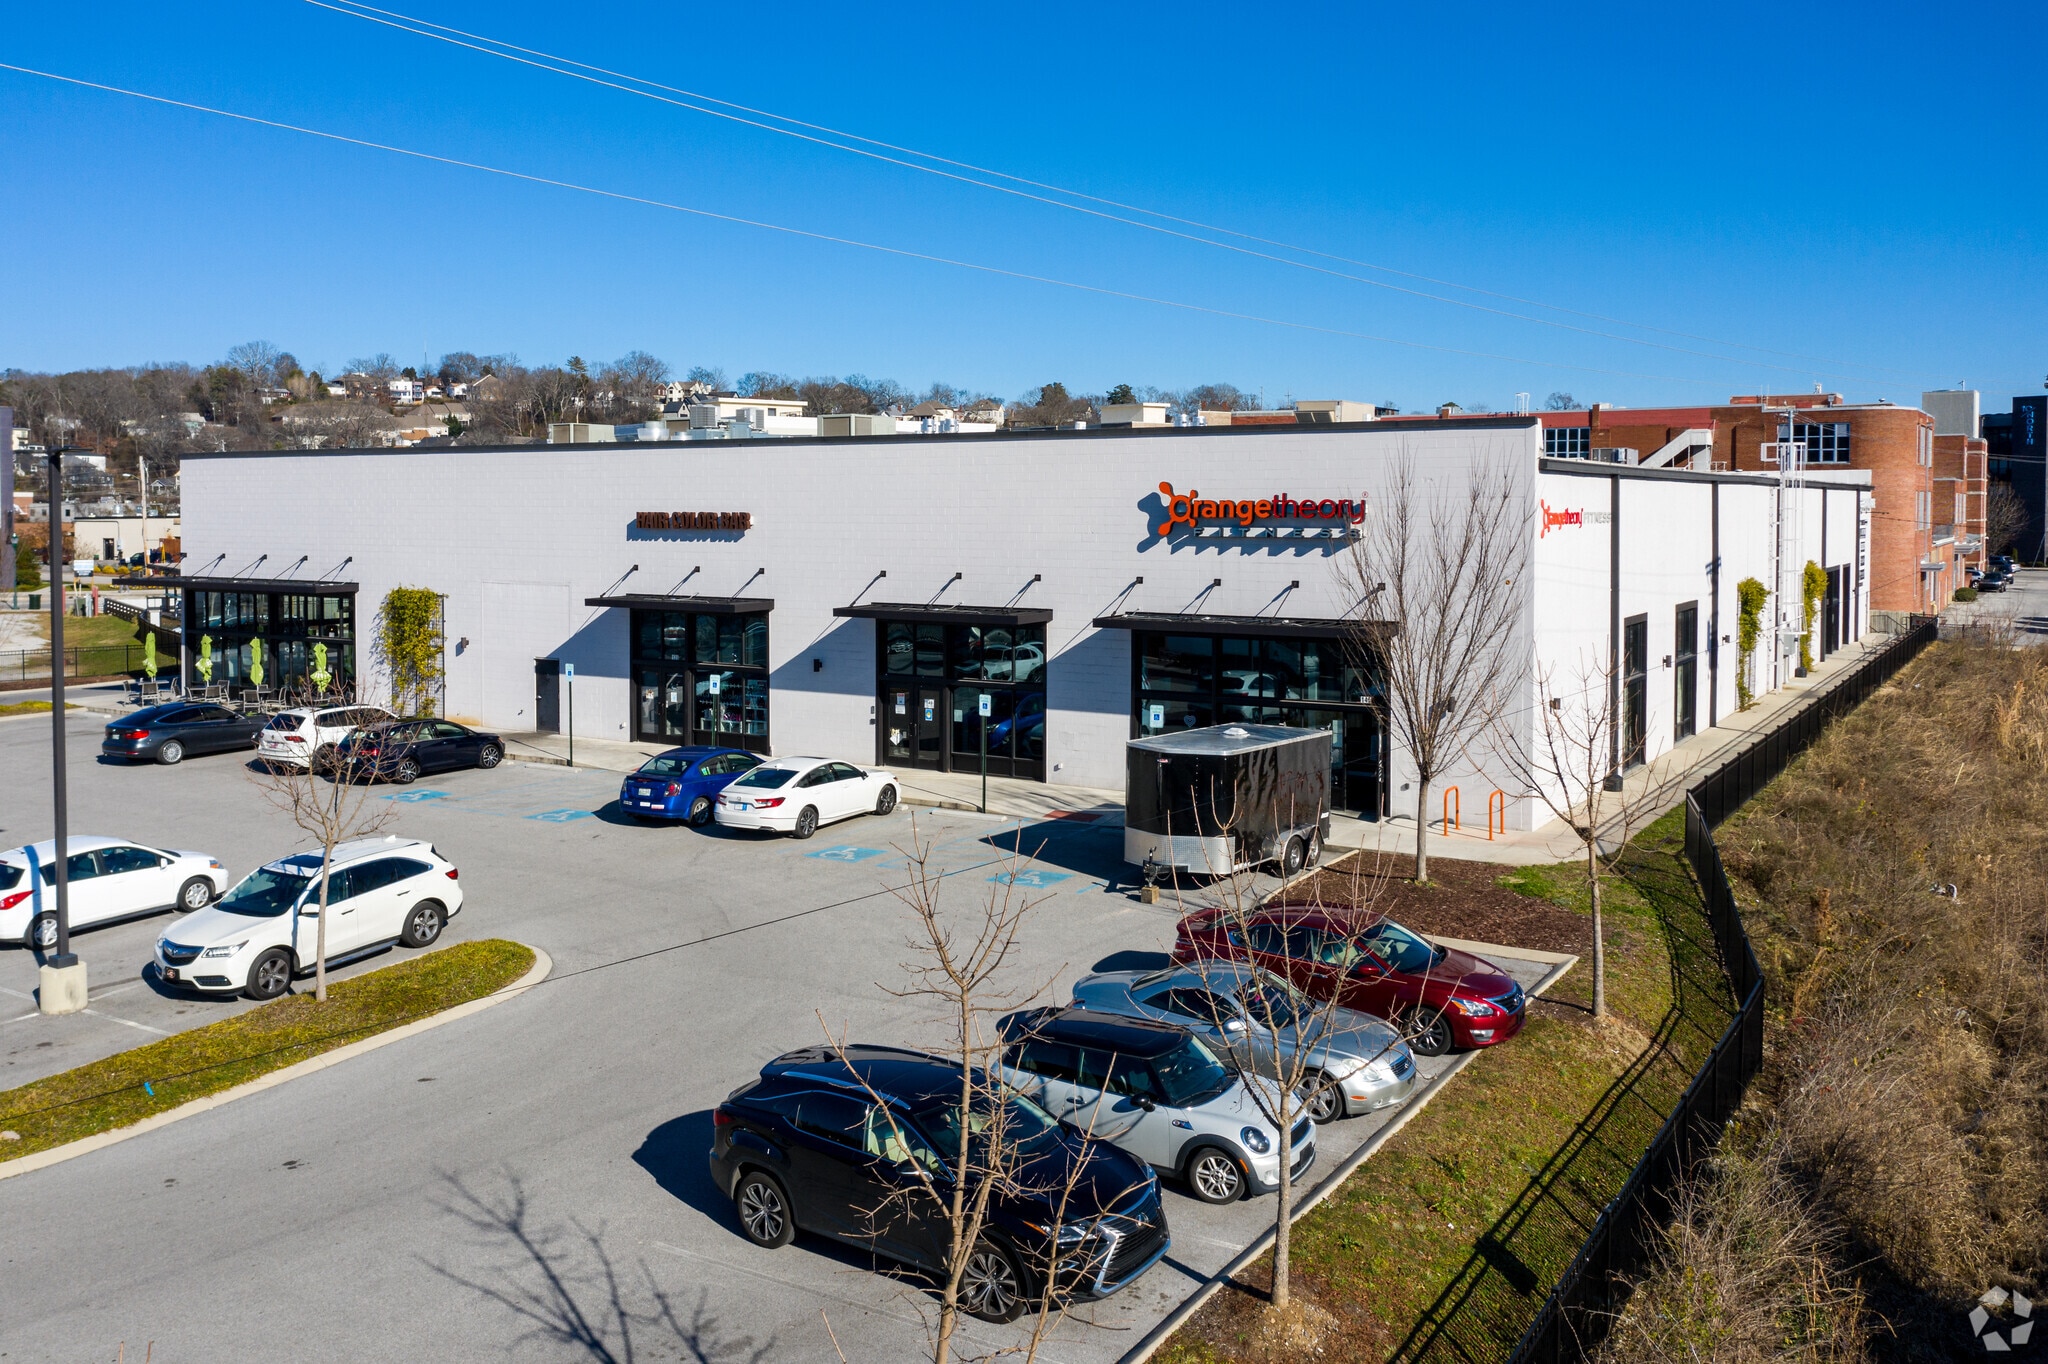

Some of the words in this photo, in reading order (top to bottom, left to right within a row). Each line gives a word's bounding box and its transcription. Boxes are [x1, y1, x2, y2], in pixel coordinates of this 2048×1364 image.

[636, 511, 669, 529] HAIR
[672, 511, 718, 529] COLOR
[721, 511, 751, 530] BAR
[1194, 527, 1360, 538] FITNESS
